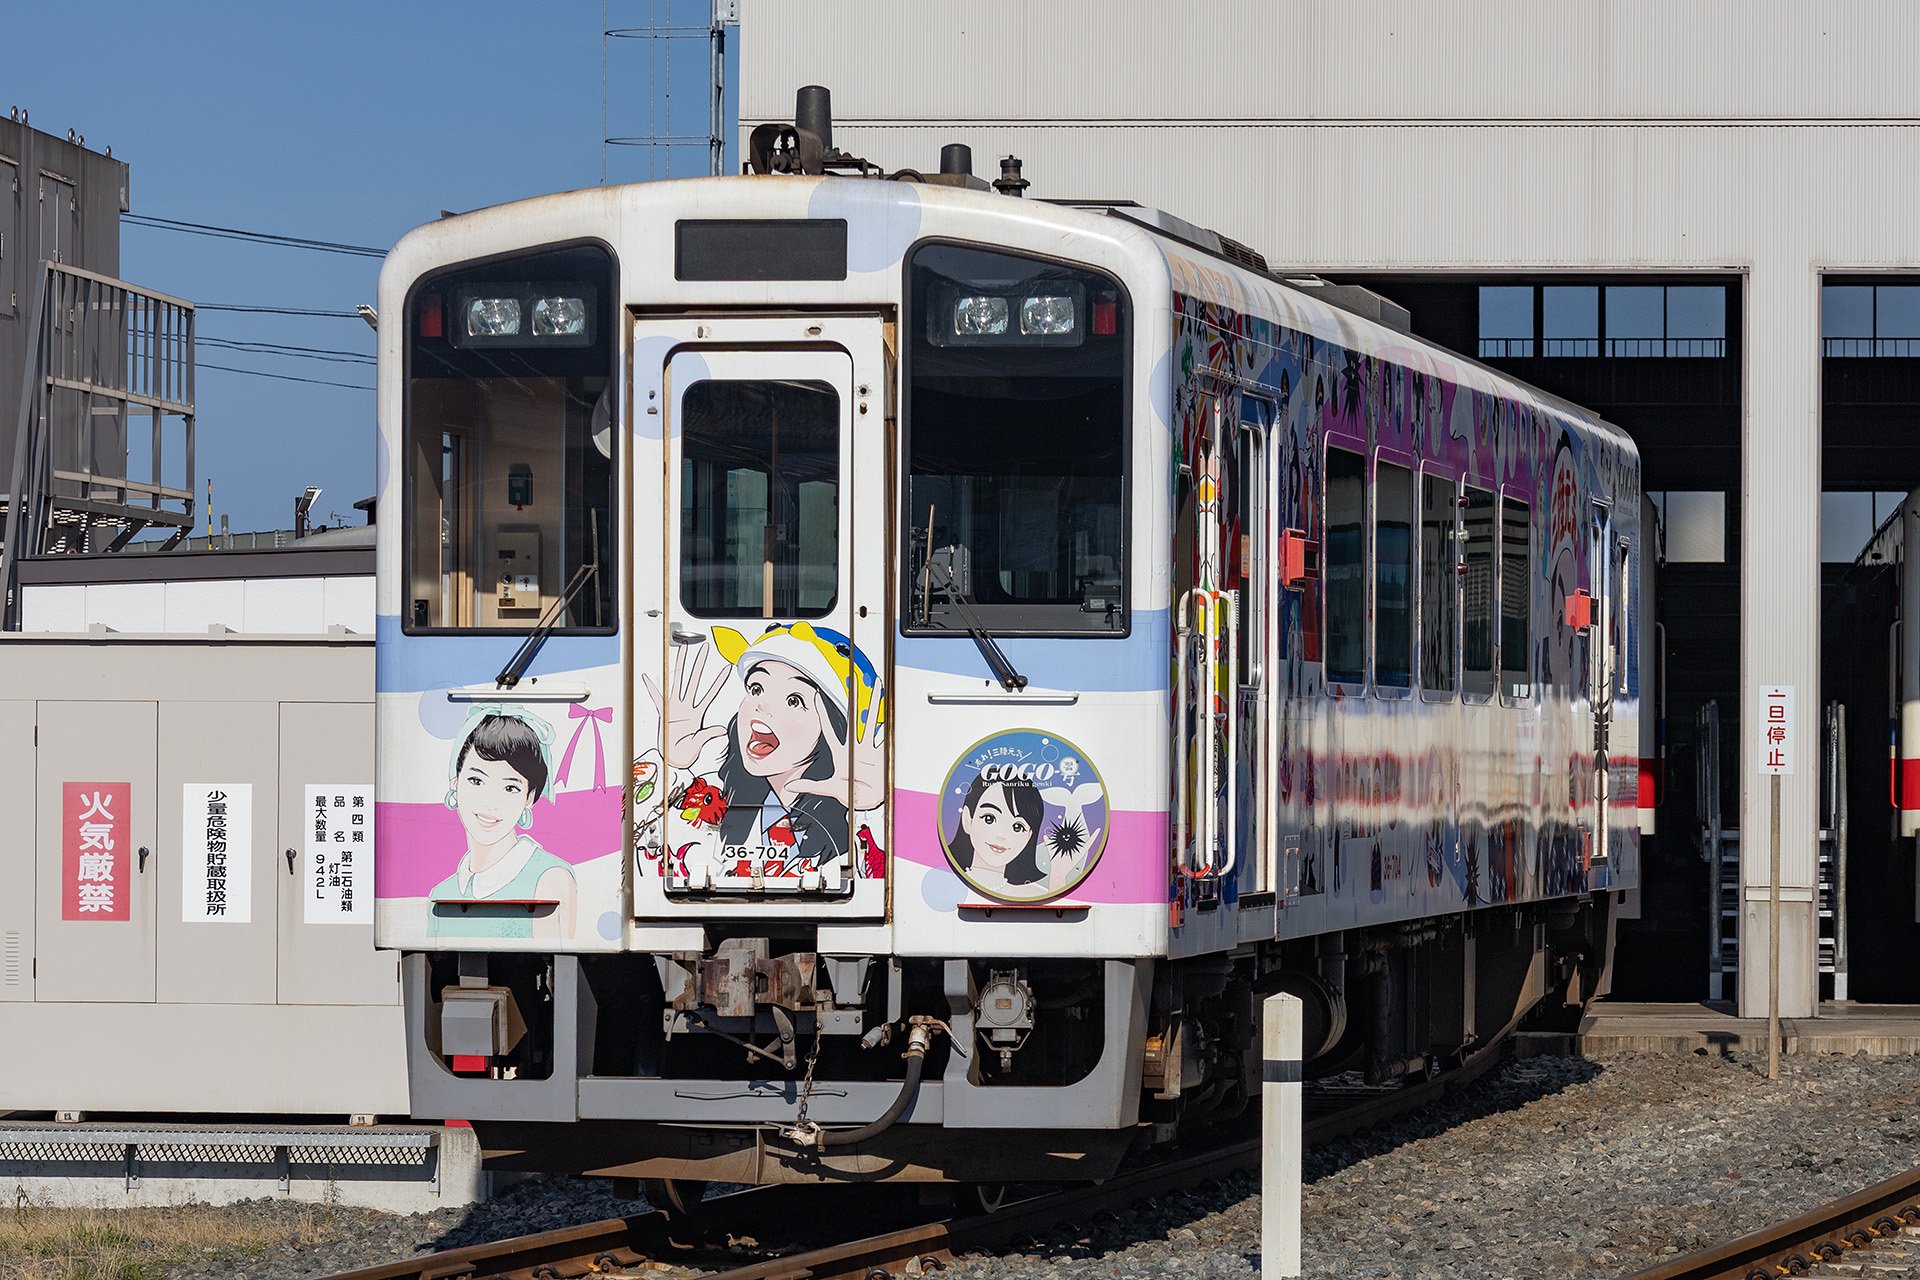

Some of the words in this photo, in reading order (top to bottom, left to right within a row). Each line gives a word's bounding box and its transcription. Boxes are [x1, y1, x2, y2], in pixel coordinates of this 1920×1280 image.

[1767, 694, 1786, 767] 一旦停止
[315, 796, 327, 843] 最大数量
[352, 796, 365, 843] 第四類
[78, 791, 114, 913] 火気厳禁
[206, 790, 227, 916] 少量危険物貯蔵取扱所
[328, 862, 341, 887] 灯油
[725, 846, 789, 860] 36-704
[315, 854, 325, 900] 942L
[341, 851, 353, 912] 第二石油類
